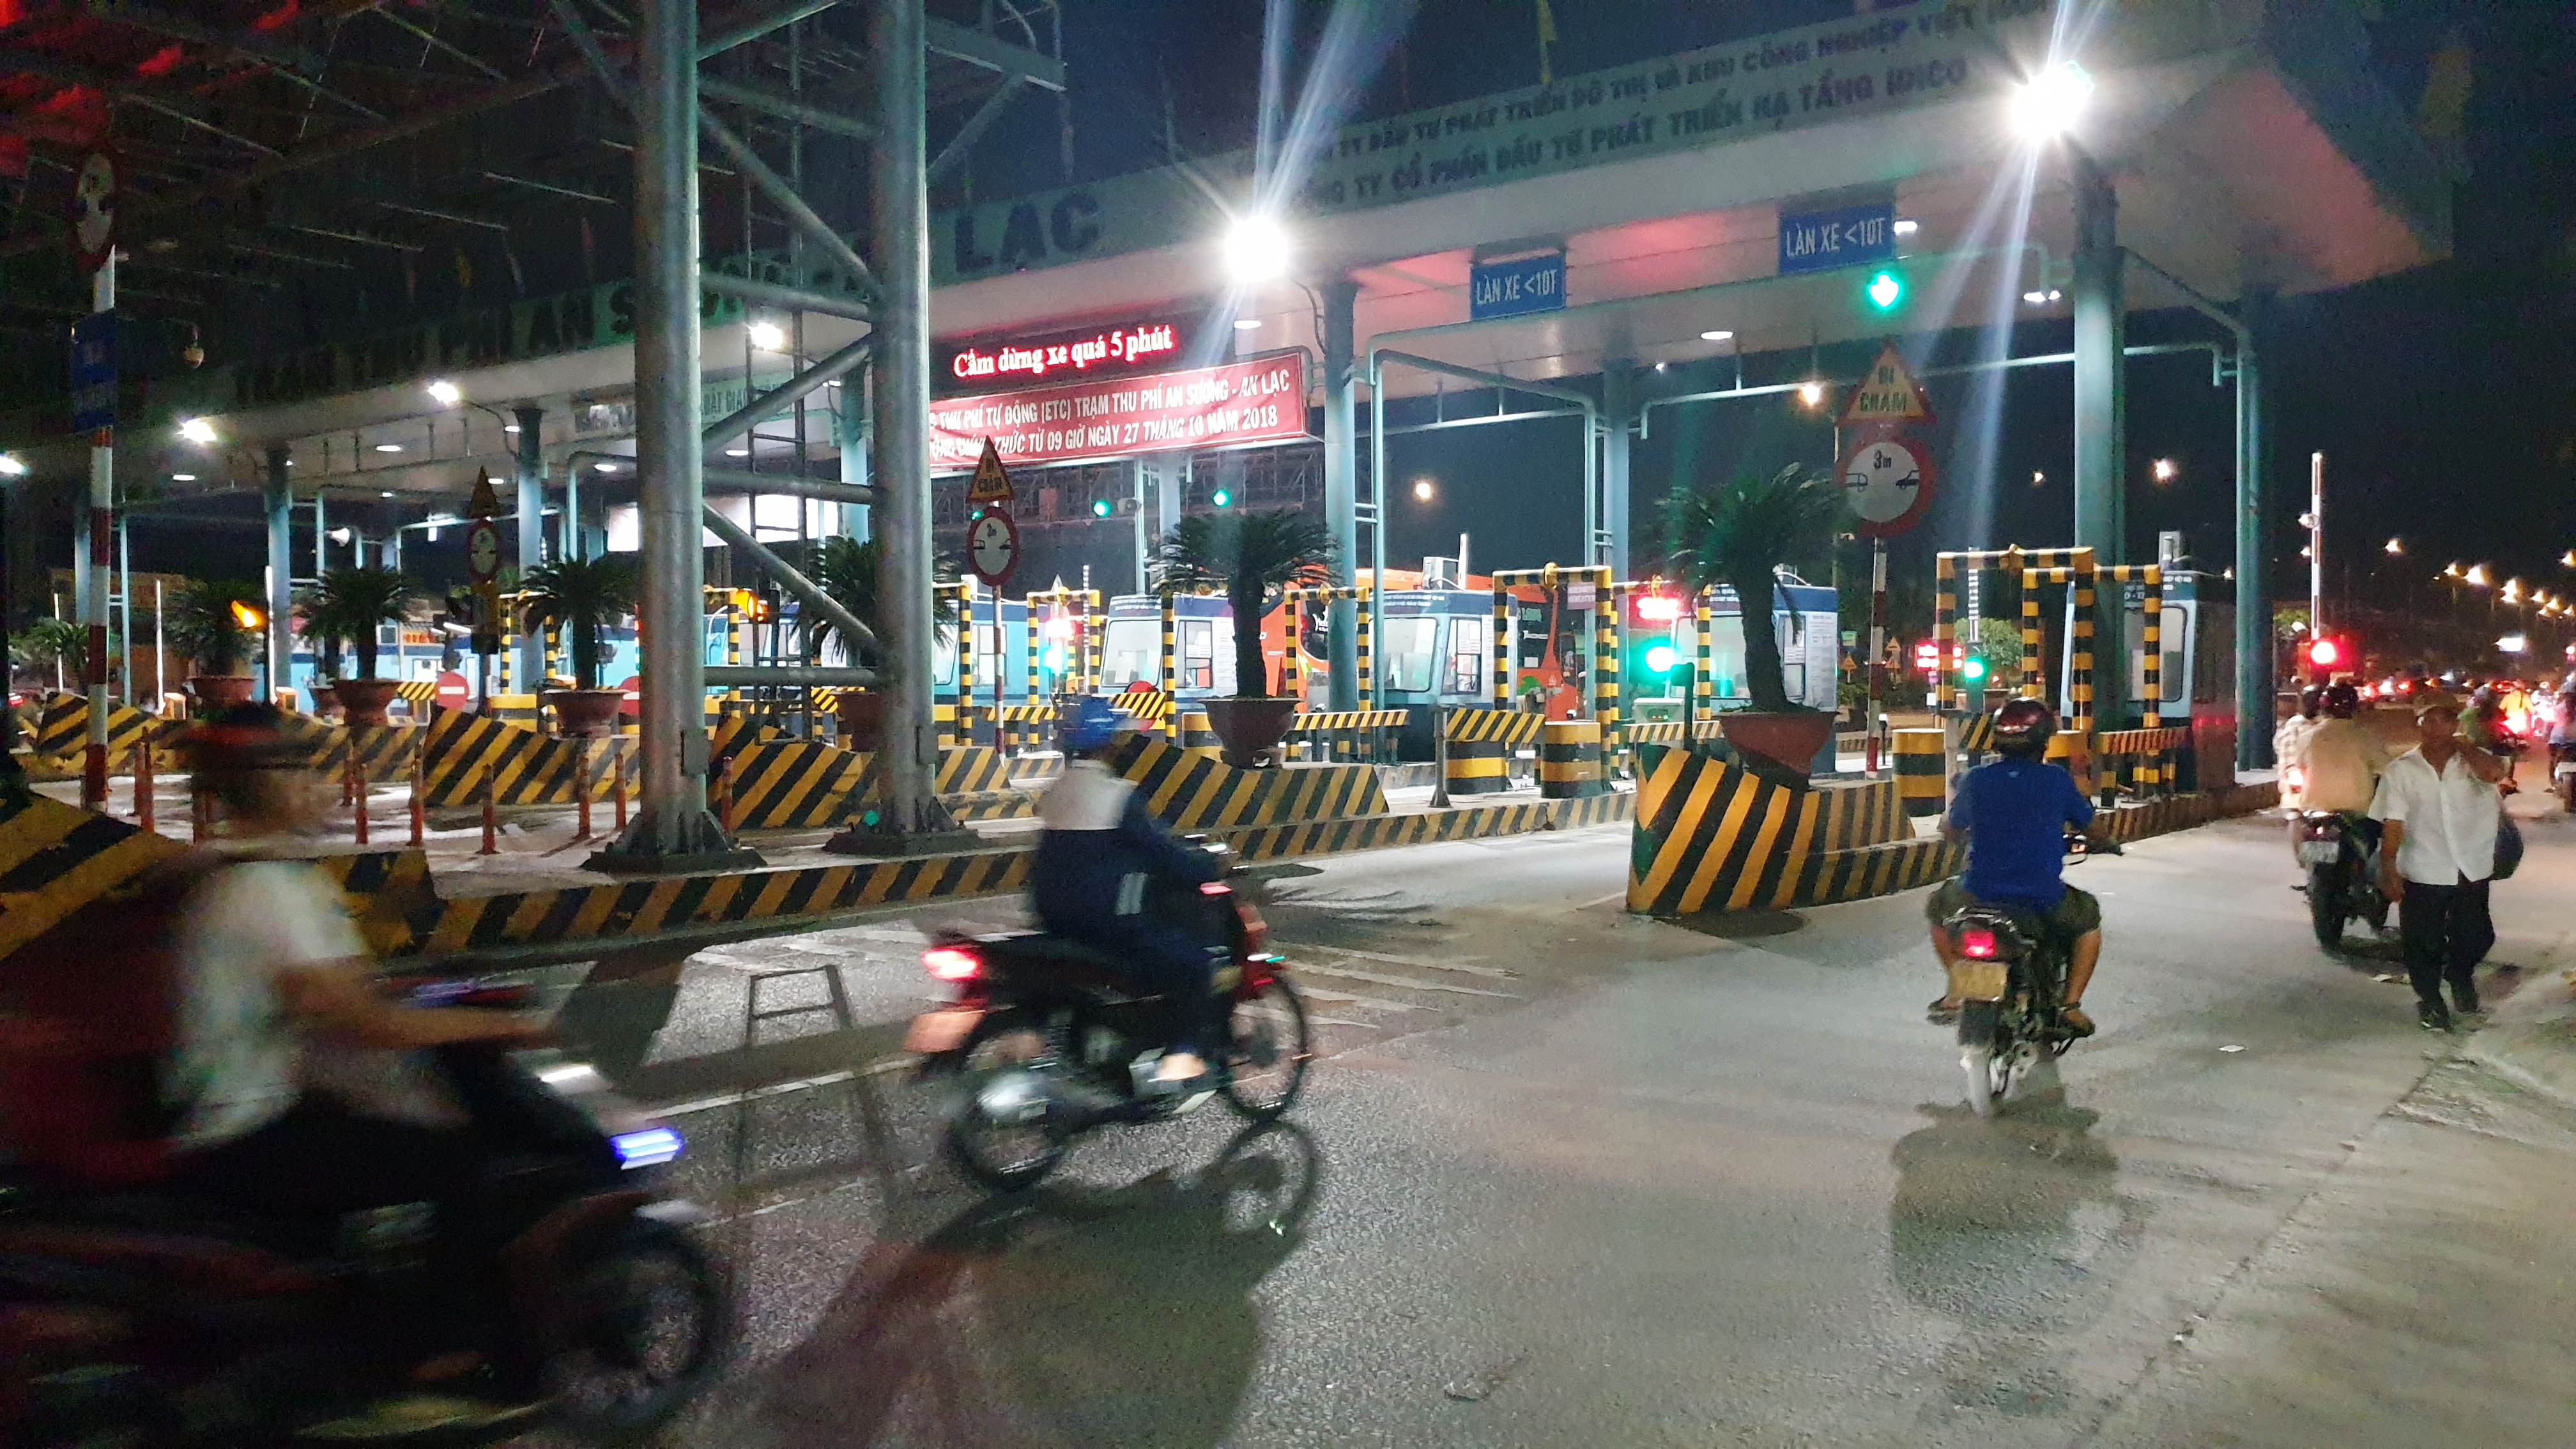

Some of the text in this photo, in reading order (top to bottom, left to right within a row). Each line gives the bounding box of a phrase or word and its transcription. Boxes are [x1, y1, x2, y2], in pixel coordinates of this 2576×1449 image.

[1591, 111, 1655, 153] PHÁT
[1786, 223, 1816, 257] LÀN
[1821, 223, 1840, 253] XE
[1476, 274, 1501, 306] LÀN
[1505, 273, 1521, 301] XE
[998, 347, 1045, 373] dừng
[1047, 346, 1067, 365] xe
[1071, 335, 1106, 367] quá
[1110, 332, 1123, 356] 5
[1126, 325, 1173, 361] phút
[940, 411, 961, 430] THU
[963, 404, 984, 429] PHÍ
[986, 404, 1002, 430] TỰ
[1004, 400, 1038, 427] ĐỘNG
[1075, 393, 1108, 420] TRẠM
[1112, 391, 1137, 413] THU
[1140, 382, 1163, 411] PHÍ
[1165, 386, 1183, 408] AN
[1239, 375, 1259, 397] AN
[1261, 369, 1289, 397] LẠC
[995, 429, 1025, 454] THỨC
[1029, 428, 1044, 452] TỪ
[1047, 431, 1062, 451] 09
[1065, 424, 1086, 450] GIỜ
[1088, 420, 1119, 446] NGÀY
[1123, 422, 1140, 444] 27
[1143, 414, 1184, 441] THÁNG
[1188, 415, 1204, 438] 10
[1207, 408, 1239, 434] NĂM
[1241, 404, 1278, 431] 2018
[1873, 450, 1892, 470] 3m
